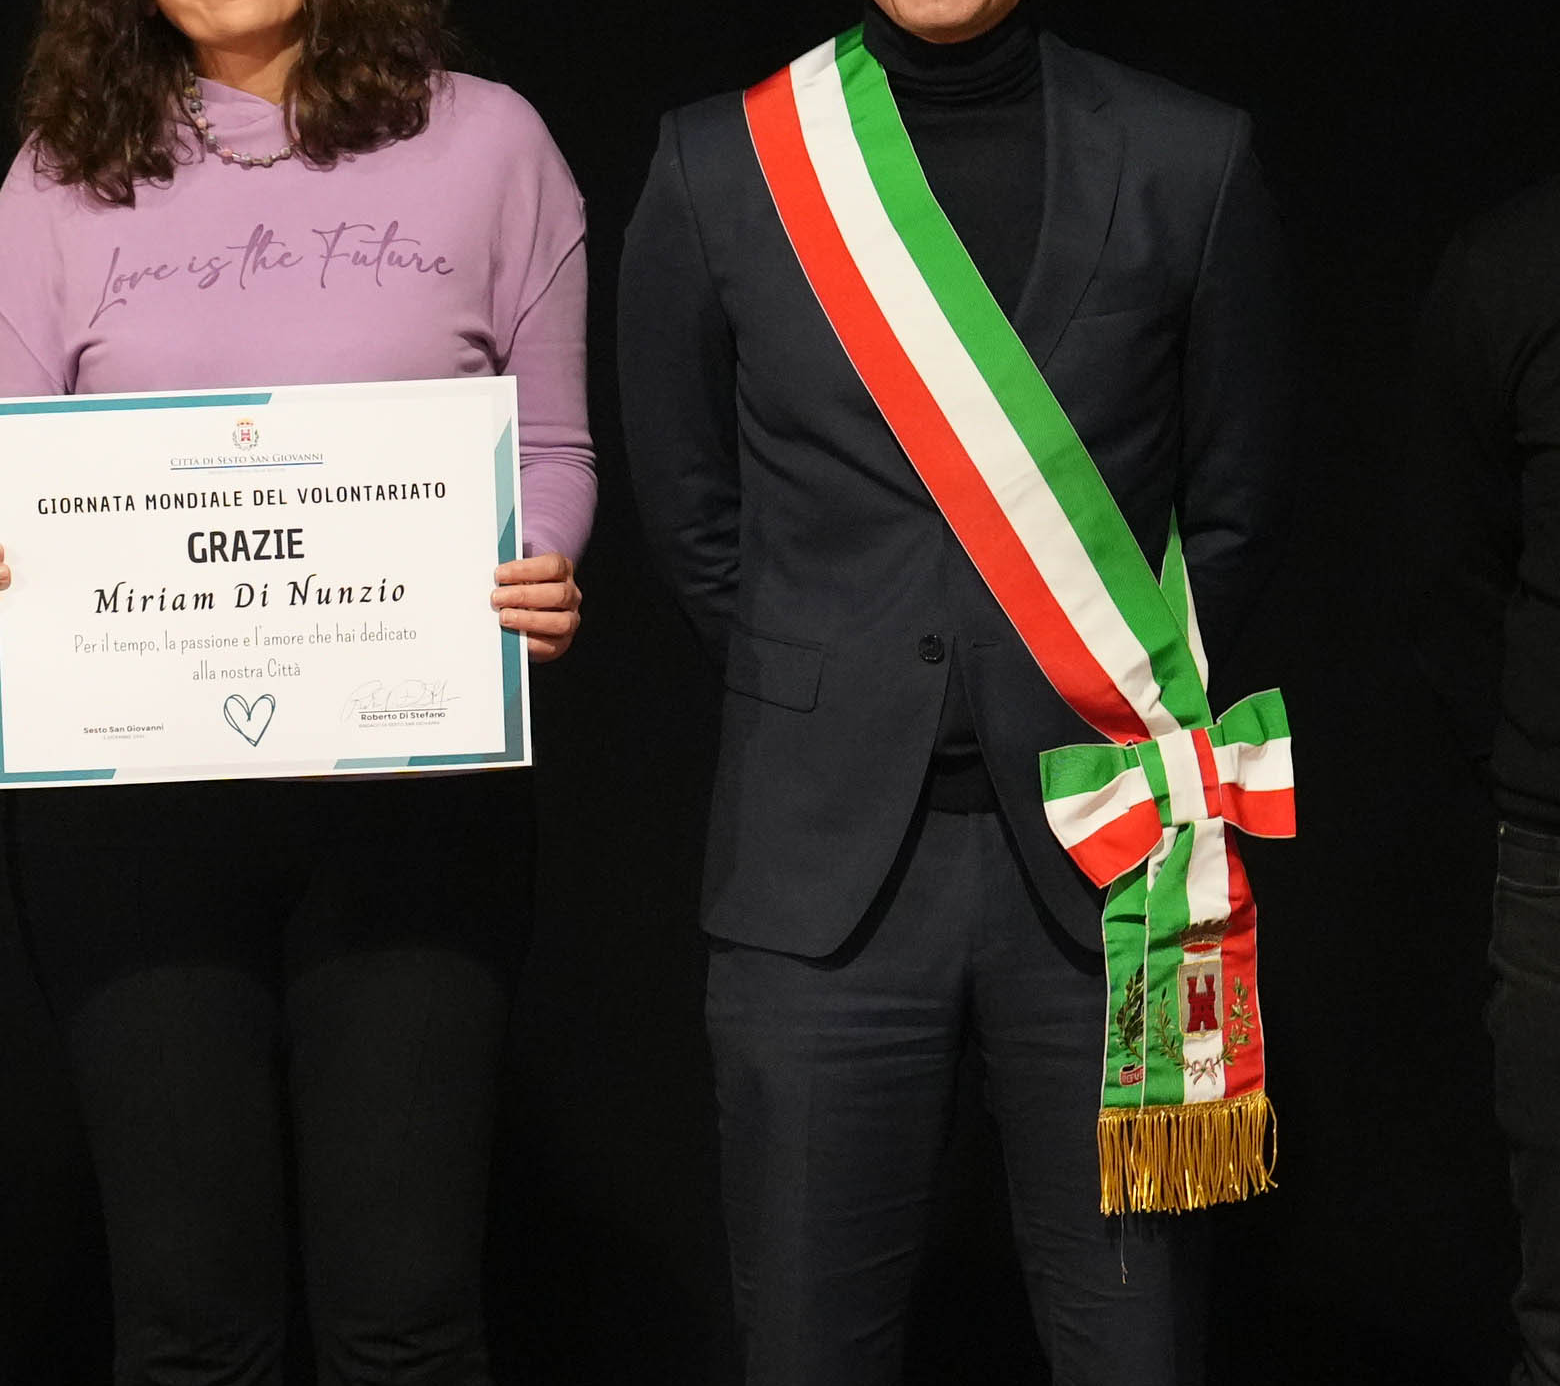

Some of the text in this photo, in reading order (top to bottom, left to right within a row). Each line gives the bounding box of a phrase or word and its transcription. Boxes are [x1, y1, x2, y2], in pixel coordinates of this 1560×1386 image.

[88, 221, 454, 328] Love is the Future
[37, 481, 446, 515] GIORNATA MONDIALE DEL VOLONTARIATO
[187, 527, 305, 564] GRAZIE
[94, 573, 405, 614] Miriam Di Nunzio
[74, 620, 417, 656] Per il tempo, la passione e l'amore che hai dedicato
[192, 657, 301, 681] alla nostra Città
